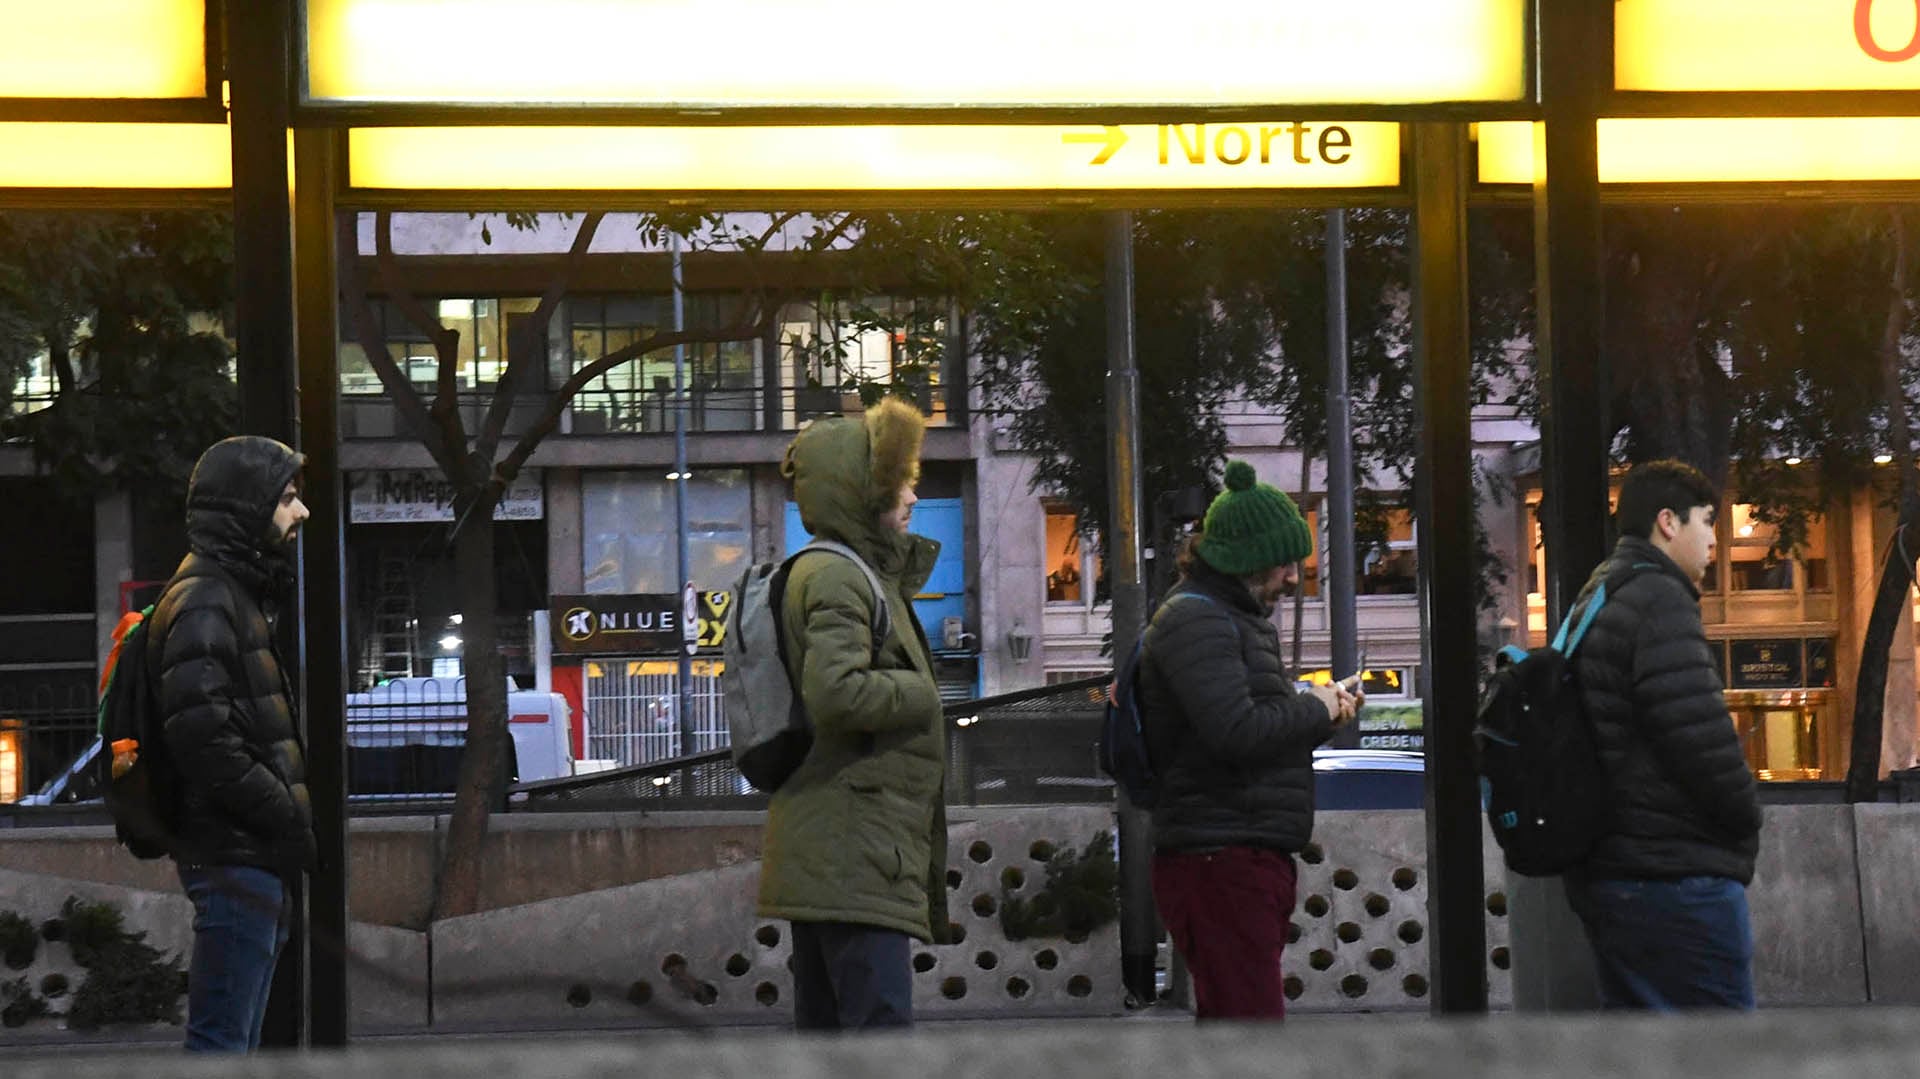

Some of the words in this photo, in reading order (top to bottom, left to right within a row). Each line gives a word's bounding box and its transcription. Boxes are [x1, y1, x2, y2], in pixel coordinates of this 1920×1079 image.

[1158, 121, 1352, 165] Norte
[600, 612, 675, 629] NIUE
[1360, 735, 1424, 748] CREDEN
